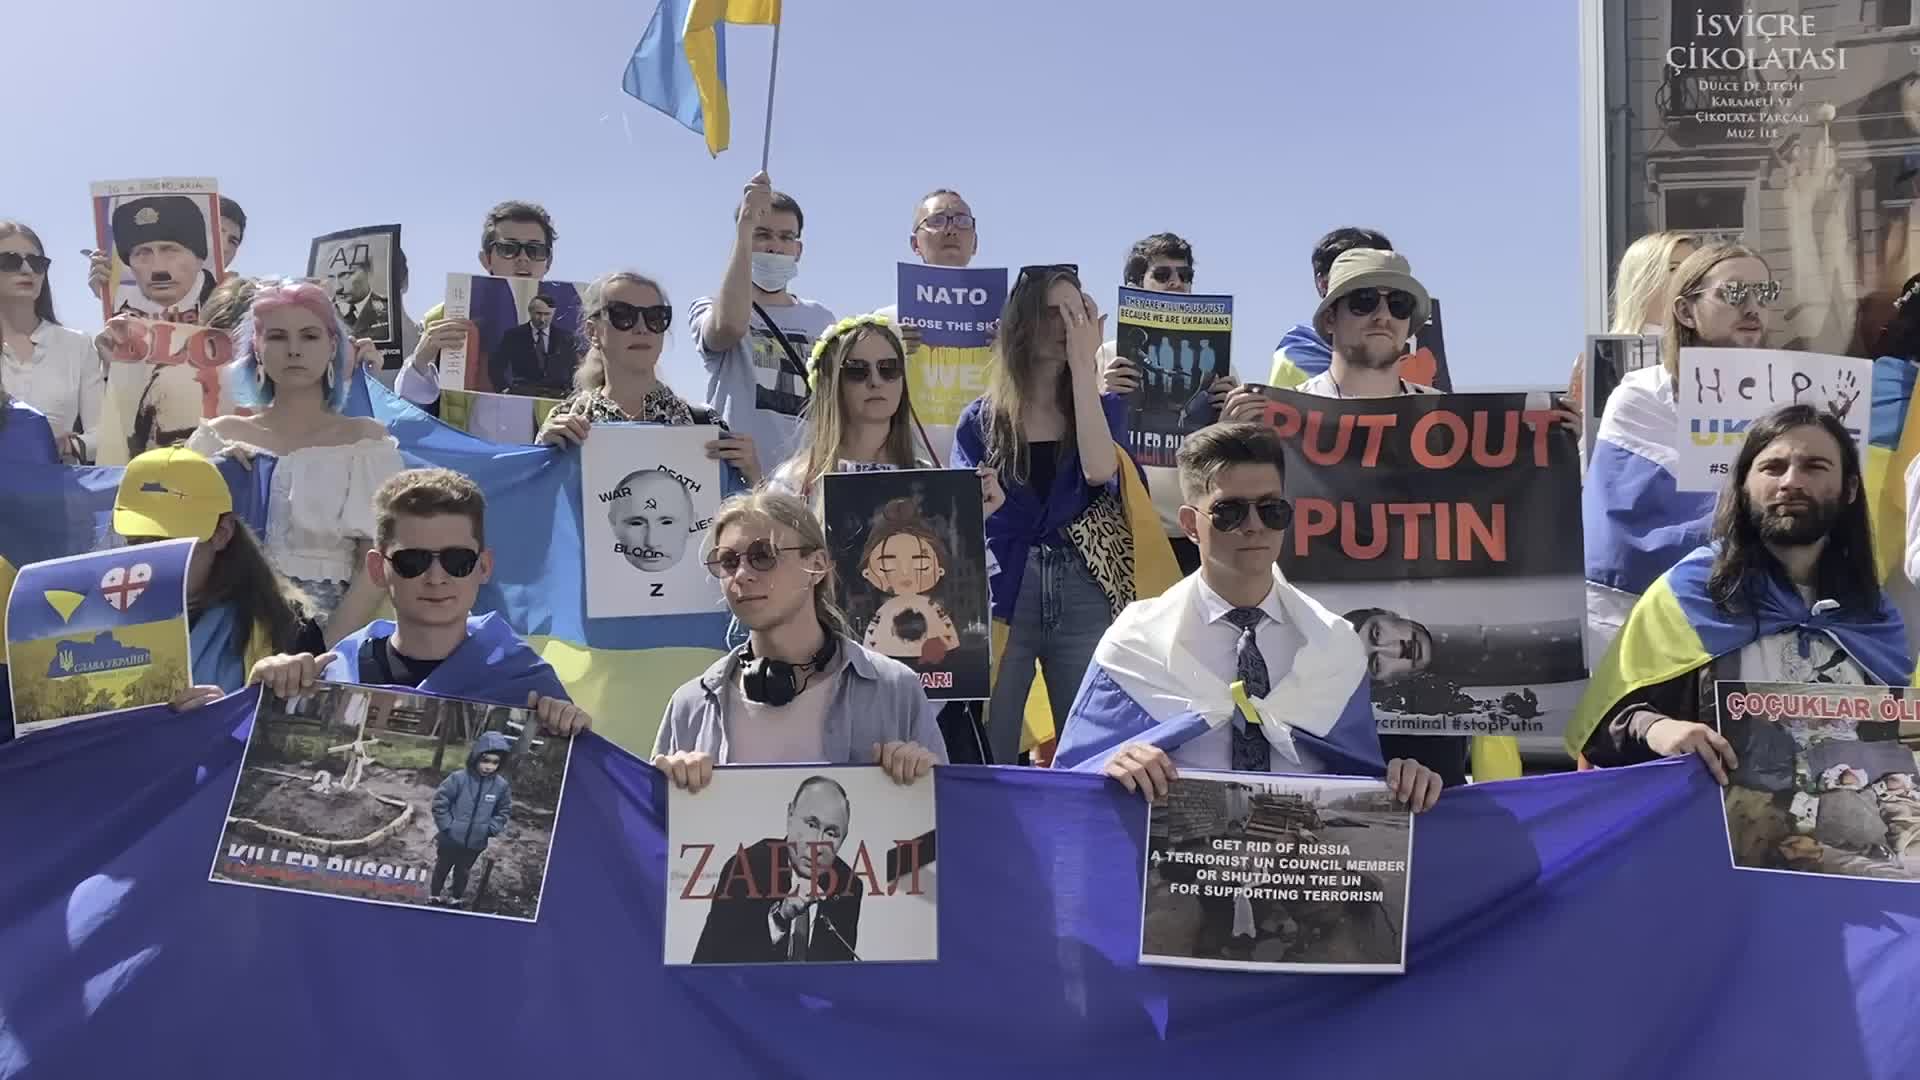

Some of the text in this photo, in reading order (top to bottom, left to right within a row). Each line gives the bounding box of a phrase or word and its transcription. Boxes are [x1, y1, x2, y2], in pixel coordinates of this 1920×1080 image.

[1696, 9, 1816, 43] İSVİÇRE
[1666, 42, 1848, 76] ÇİKOLATASI
[916, 284, 988, 305] NATO
[902, 316, 999, 331] CLOSE THE SK
[1121, 307, 1151, 320] BECAUSE
[1182, 316, 1229, 325] UKRAINIANS
[111, 318, 233, 369] BLO
[1696, 363, 1812, 406] Help
[1263, 402, 1562, 469] PUT OUT
[656, 465, 701, 492] DEATH
[1709, 463, 1728, 474] #S
[599, 487, 632, 502] WAR
[1294, 498, 1507, 562] PUTIN
[613, 543, 664, 559] BLOOD
[650, 584, 664, 597] Z
[919, 672, 953, 688] AR!
[1727, 692, 1871, 721] ÇOÇUKLAR
[1452, 717, 1543, 733] #stopPutin
[1212, 839, 1351, 856] GET RID OF RUSSIA
[225, 843, 427, 896] KILLER RUSSIA!
[1150, 850, 1405, 872] A TERRORIST UN COUNCIL MEMBER
[1196, 869, 1362, 887] OR SHUTDOWN THE UN
[1170, 883, 1384, 902] FOR SUPPORTING TERRORISM
